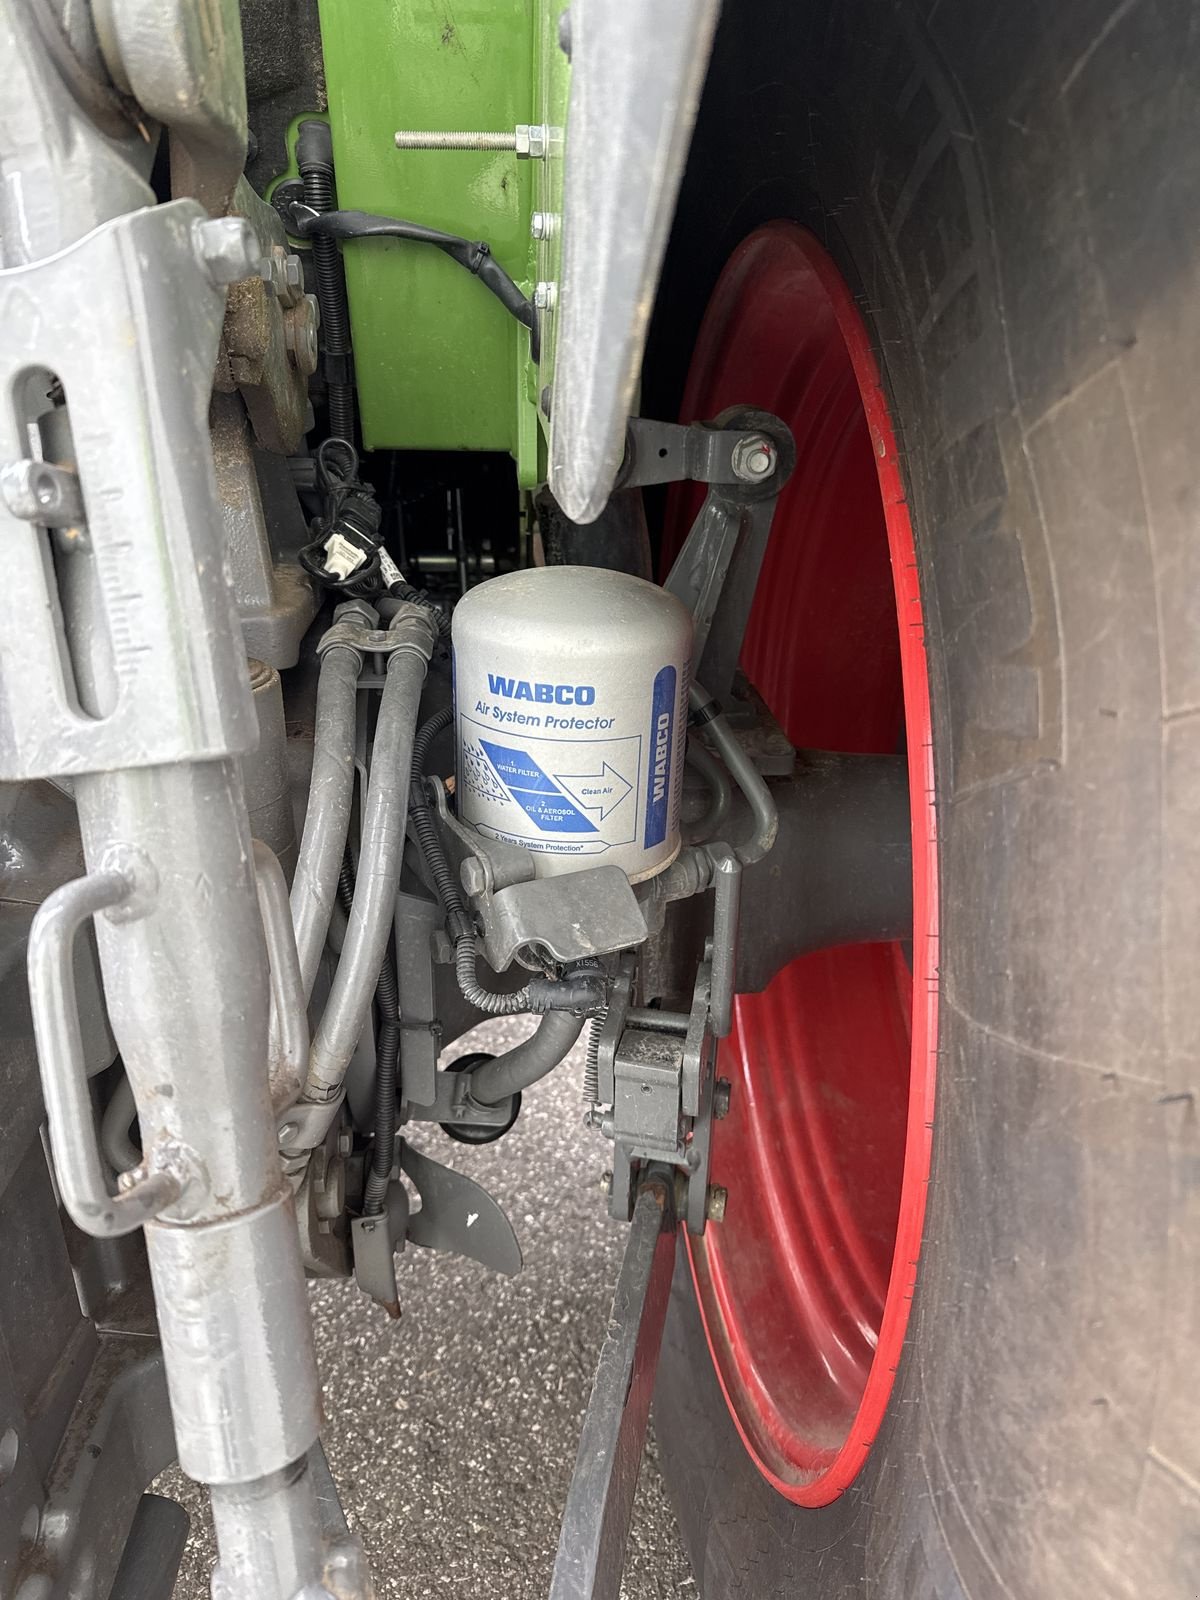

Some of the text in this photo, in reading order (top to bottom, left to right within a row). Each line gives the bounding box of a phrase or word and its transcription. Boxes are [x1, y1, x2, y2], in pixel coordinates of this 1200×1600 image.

[487, 673, 596, 706] WABCO
[475, 700, 616, 730] Air System Protector
[653, 712, 670, 804] WABCO
[496, 764, 540, 778] WATER FILTER
[540, 814, 564, 822] FILTER
[543, 808, 576, 816] AEROSOL
[500, 834, 518, 845] Years
[518, 840, 544, 852] System
